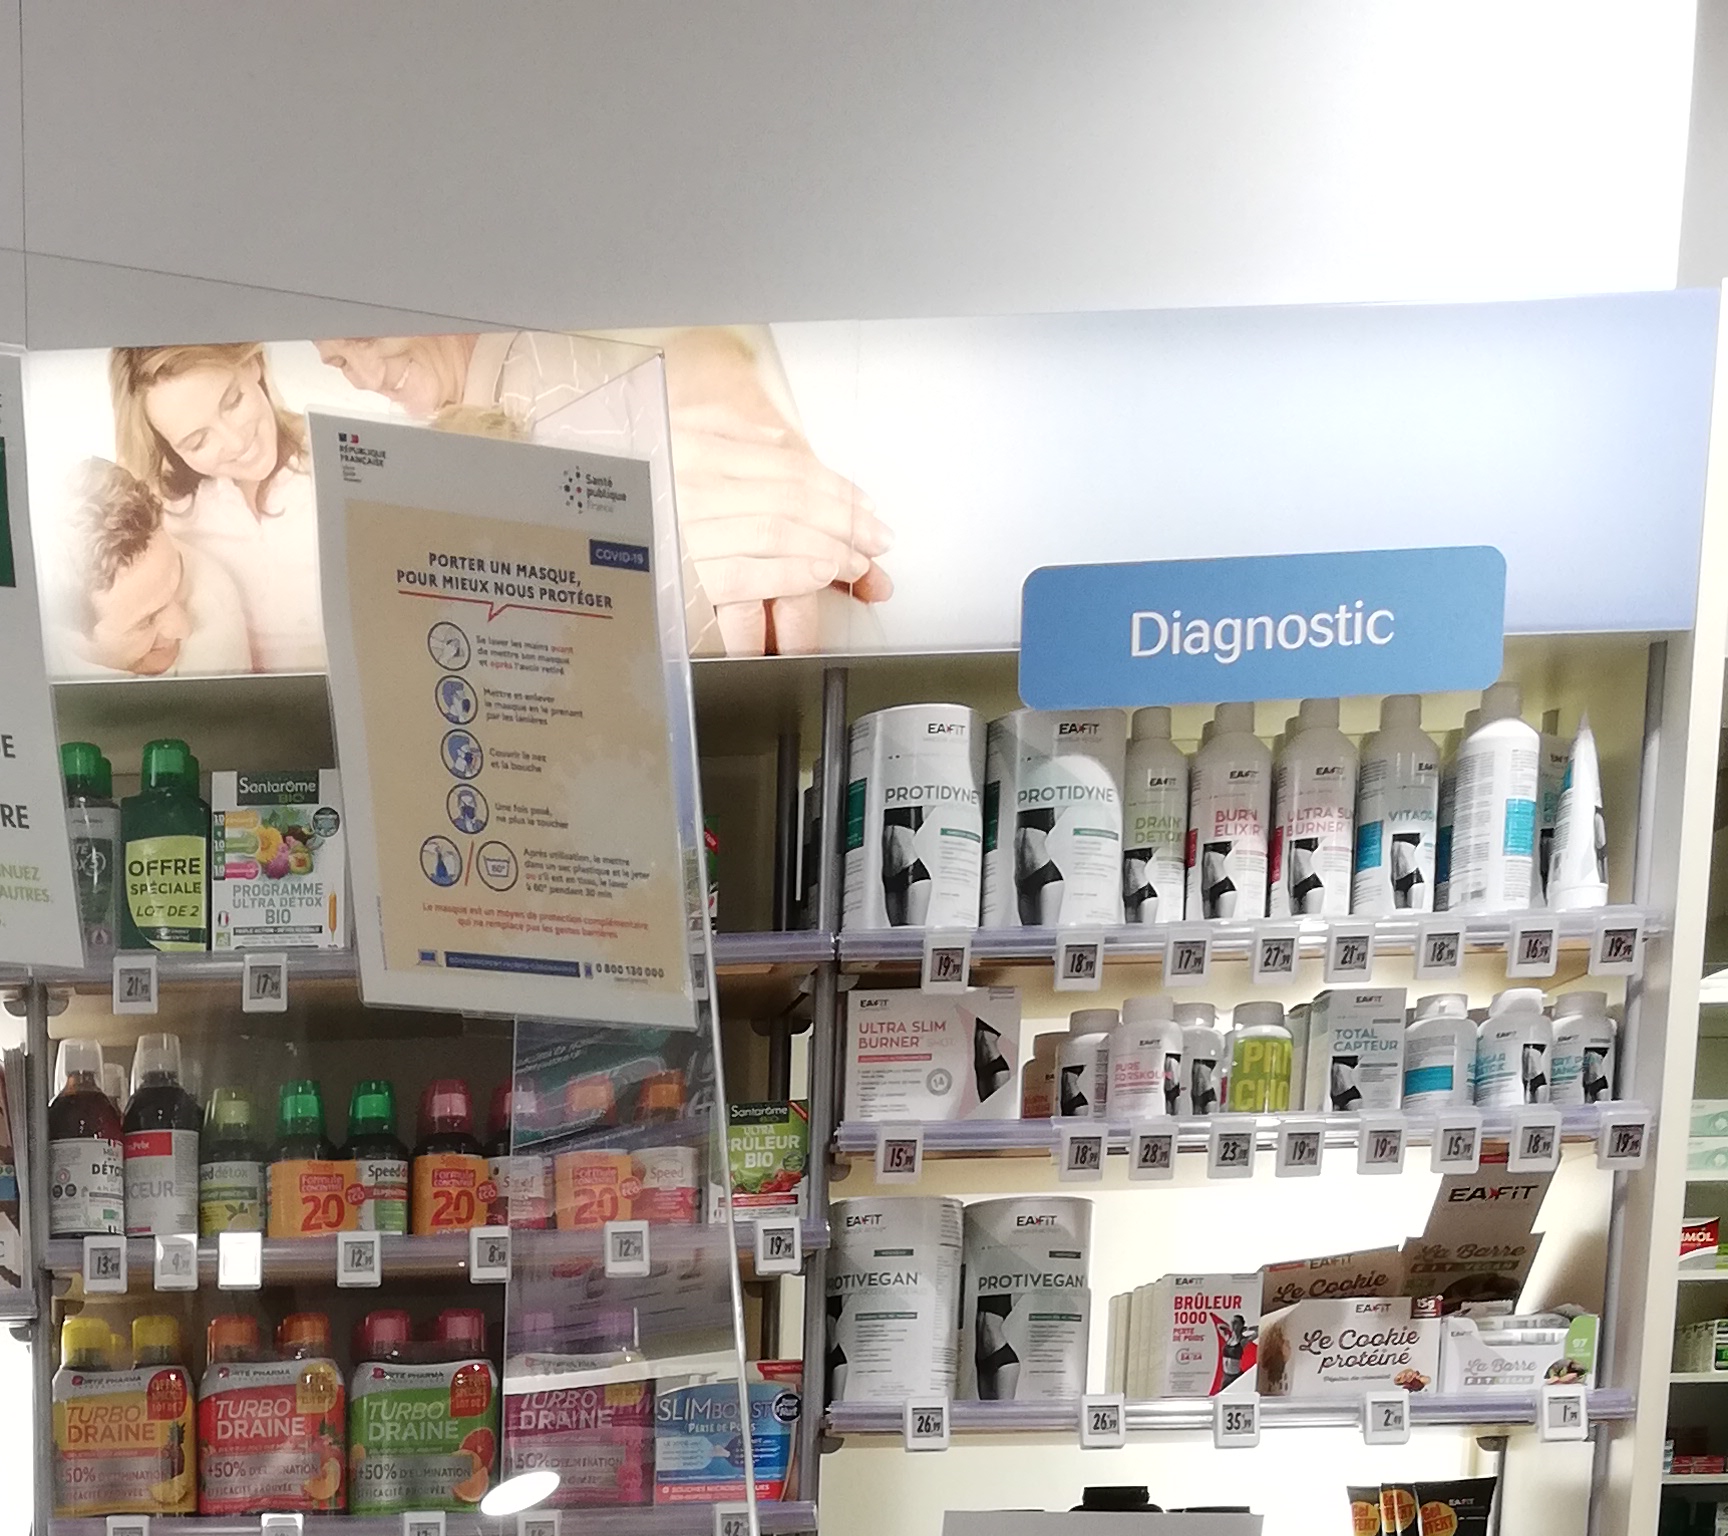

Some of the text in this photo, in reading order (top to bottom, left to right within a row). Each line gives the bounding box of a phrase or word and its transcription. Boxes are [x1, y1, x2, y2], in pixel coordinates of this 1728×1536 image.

[594, 548, 645, 566] COVID-19
[428, 551, 582, 588] PORTER UN MASQUE,
[396, 569, 613, 609] POUR MIEUX NOUS PROTÉGER
[1131, 600, 1395, 664] Diagnostic
[885, 784, 980, 804] PROTIDYNE
[1018, 785, 1114, 804] PROTIDYNE
[128, 857, 201, 877] OFFRE
[130, 881, 202, 896] SPÉCIALE
[232, 883, 323, 897] PROGRAMME
[135, 905, 199, 918] LOT DE 2
[232, 897, 275, 908] ULTRA
[265, 908, 291, 925] BIO
[859, 1021, 946, 1034] ULTRA SLIM
[1335, 1029, 1378, 1040] TOTAL
[858, 1035, 920, 1049] BURNER
[1333, 1040, 1398, 1052] CAPTEUR
[978, 1274, 1084, 1291] PROTIVEGAN
[1174, 1292, 1242, 1311] BRÛLEUR
[1174, 1311, 1207, 1325] 1000
[1299, 1326, 1420, 1353] Le Cookie
[1317, 1349, 1412, 1374] protéiné
[216, 1400, 291, 1419] TURBO
[217, 1417, 306, 1439] DRAINE
